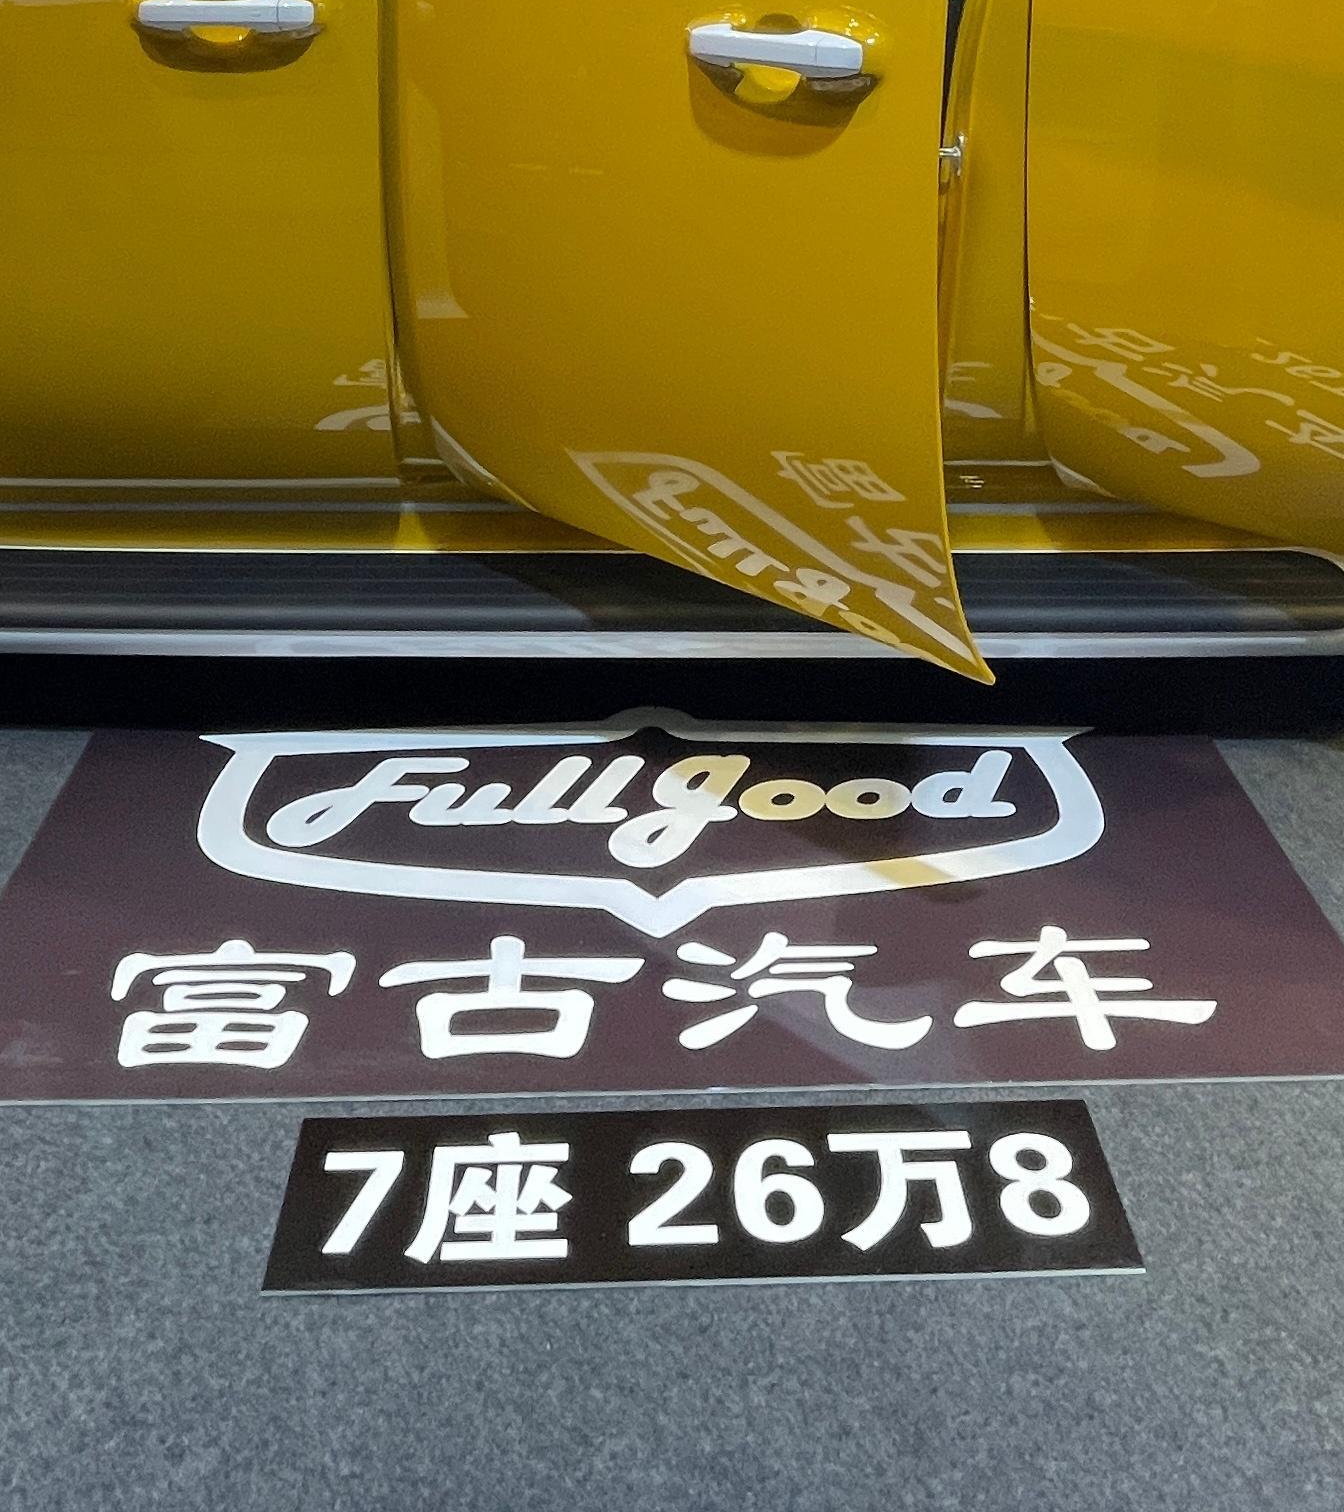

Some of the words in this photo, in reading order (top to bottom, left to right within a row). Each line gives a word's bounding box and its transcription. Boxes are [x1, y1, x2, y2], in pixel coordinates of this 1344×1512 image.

[265, 749, 1017, 868] Fullgood
[110, 925, 1218, 1071] 富古汽车
[319, 1131, 575, 1265] 7座
[626, 1129, 1093, 1252] 26万8
